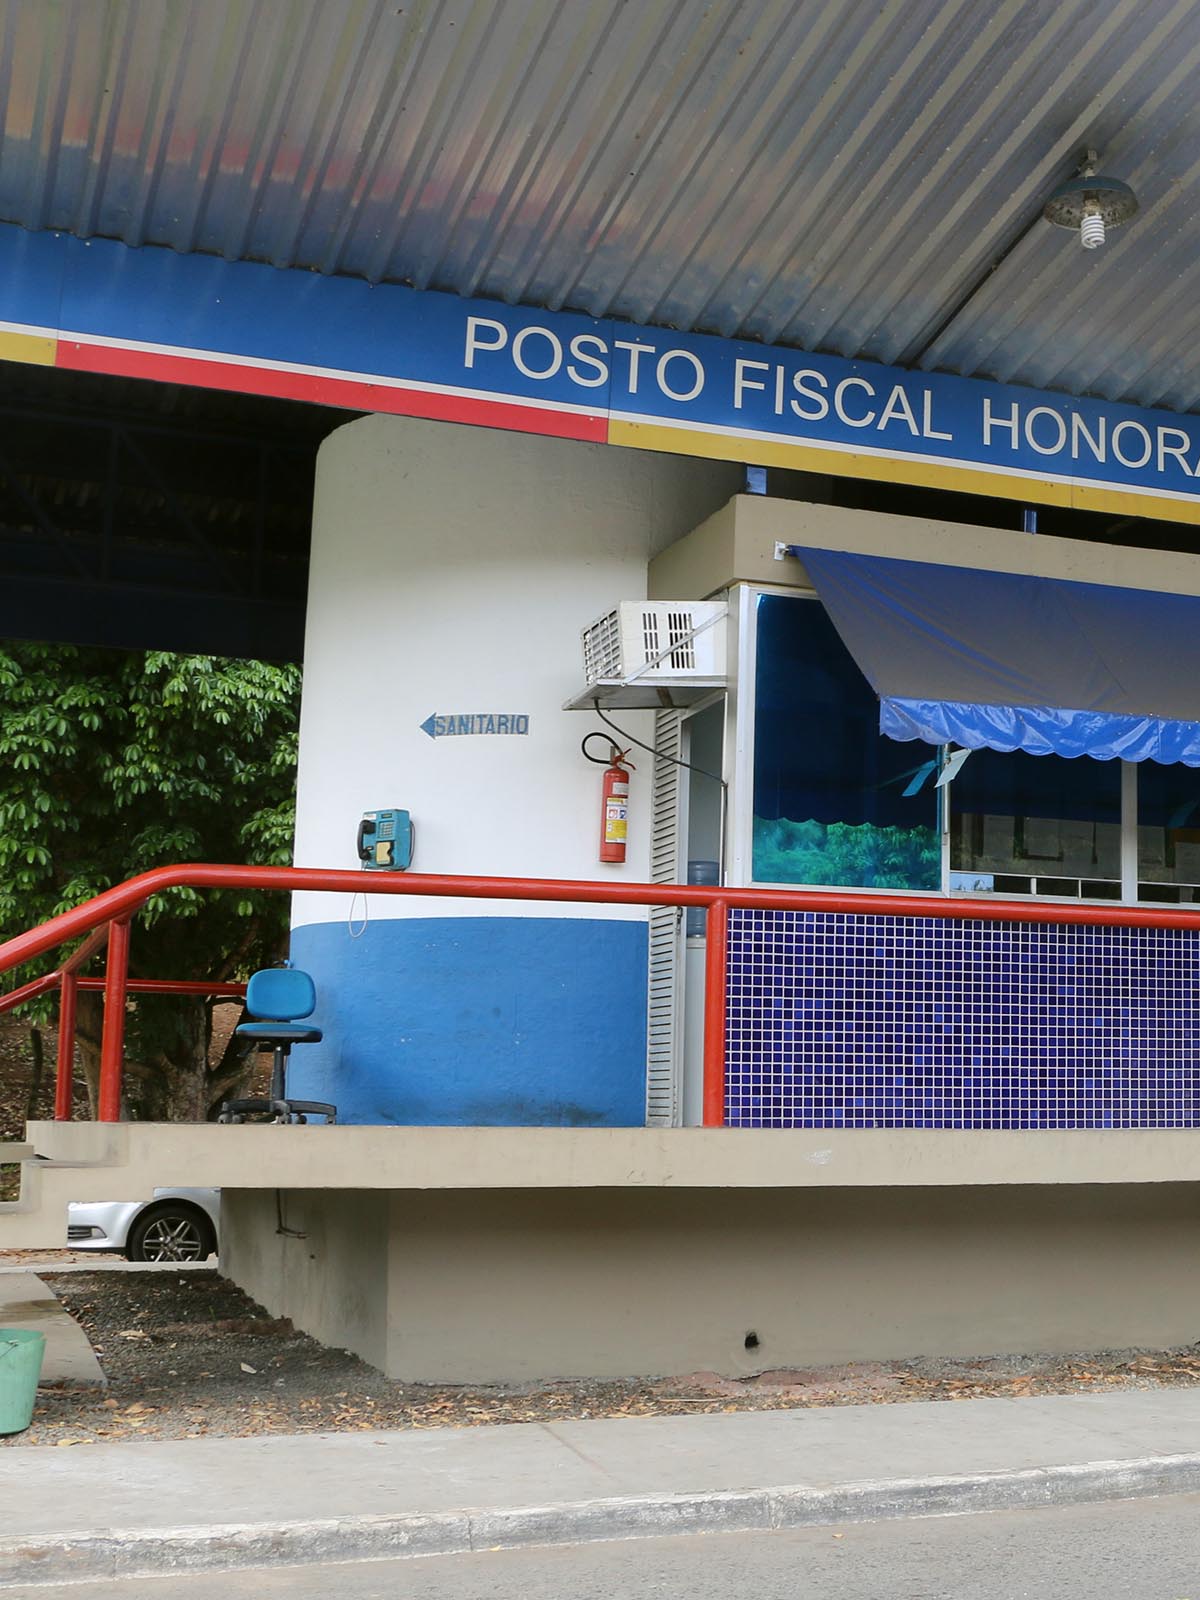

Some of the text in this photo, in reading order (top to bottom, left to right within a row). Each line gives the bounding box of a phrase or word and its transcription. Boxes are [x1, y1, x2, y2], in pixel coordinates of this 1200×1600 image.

[464, 316, 705, 401] POSTO
[734, 358, 954, 441] FISCAL
[435, 713, 529, 736] SANITARIO
